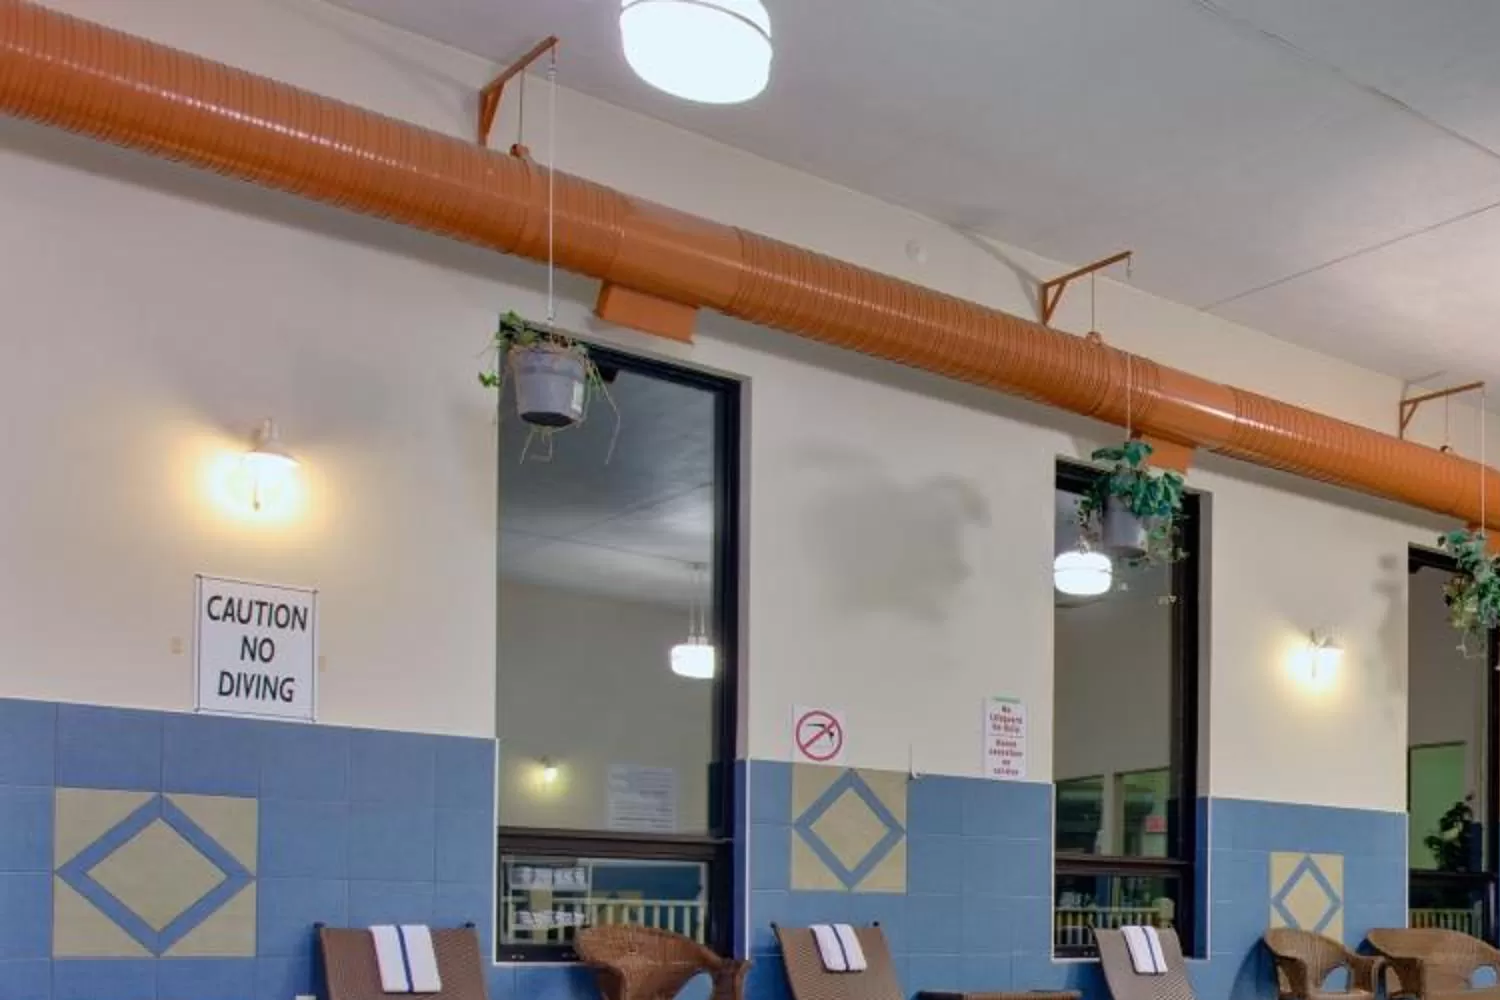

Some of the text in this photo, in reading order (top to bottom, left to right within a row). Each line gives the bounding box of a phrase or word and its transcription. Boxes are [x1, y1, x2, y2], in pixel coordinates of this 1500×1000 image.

[207, 595, 308, 632] CAUTION
[240, 635, 275, 663] NO
[217, 670, 295, 703] DIVING
